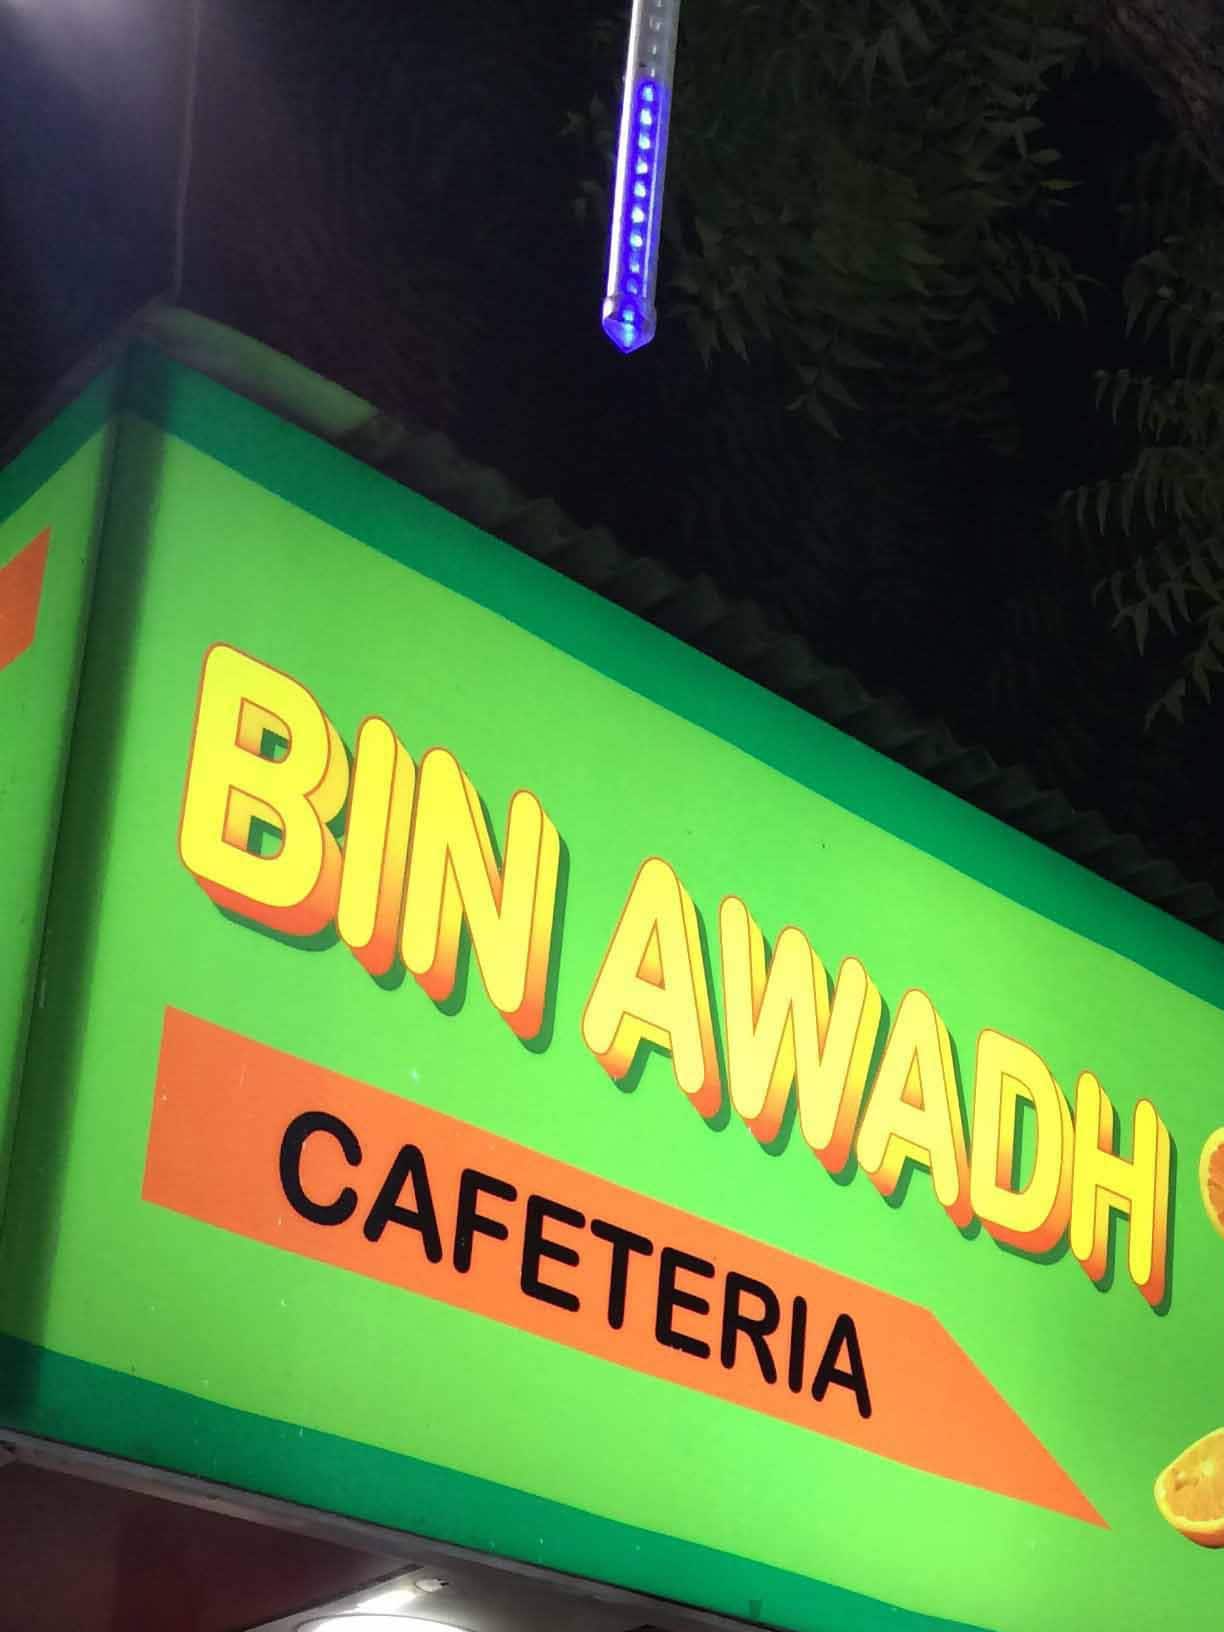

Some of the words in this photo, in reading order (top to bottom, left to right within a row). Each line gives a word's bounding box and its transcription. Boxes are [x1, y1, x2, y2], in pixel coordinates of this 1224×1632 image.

[178, 641, 563, 1040] BIN
[582, 857, 1171, 1308] AWADH
[279, 1111, 872, 1419] CAFETERIA
